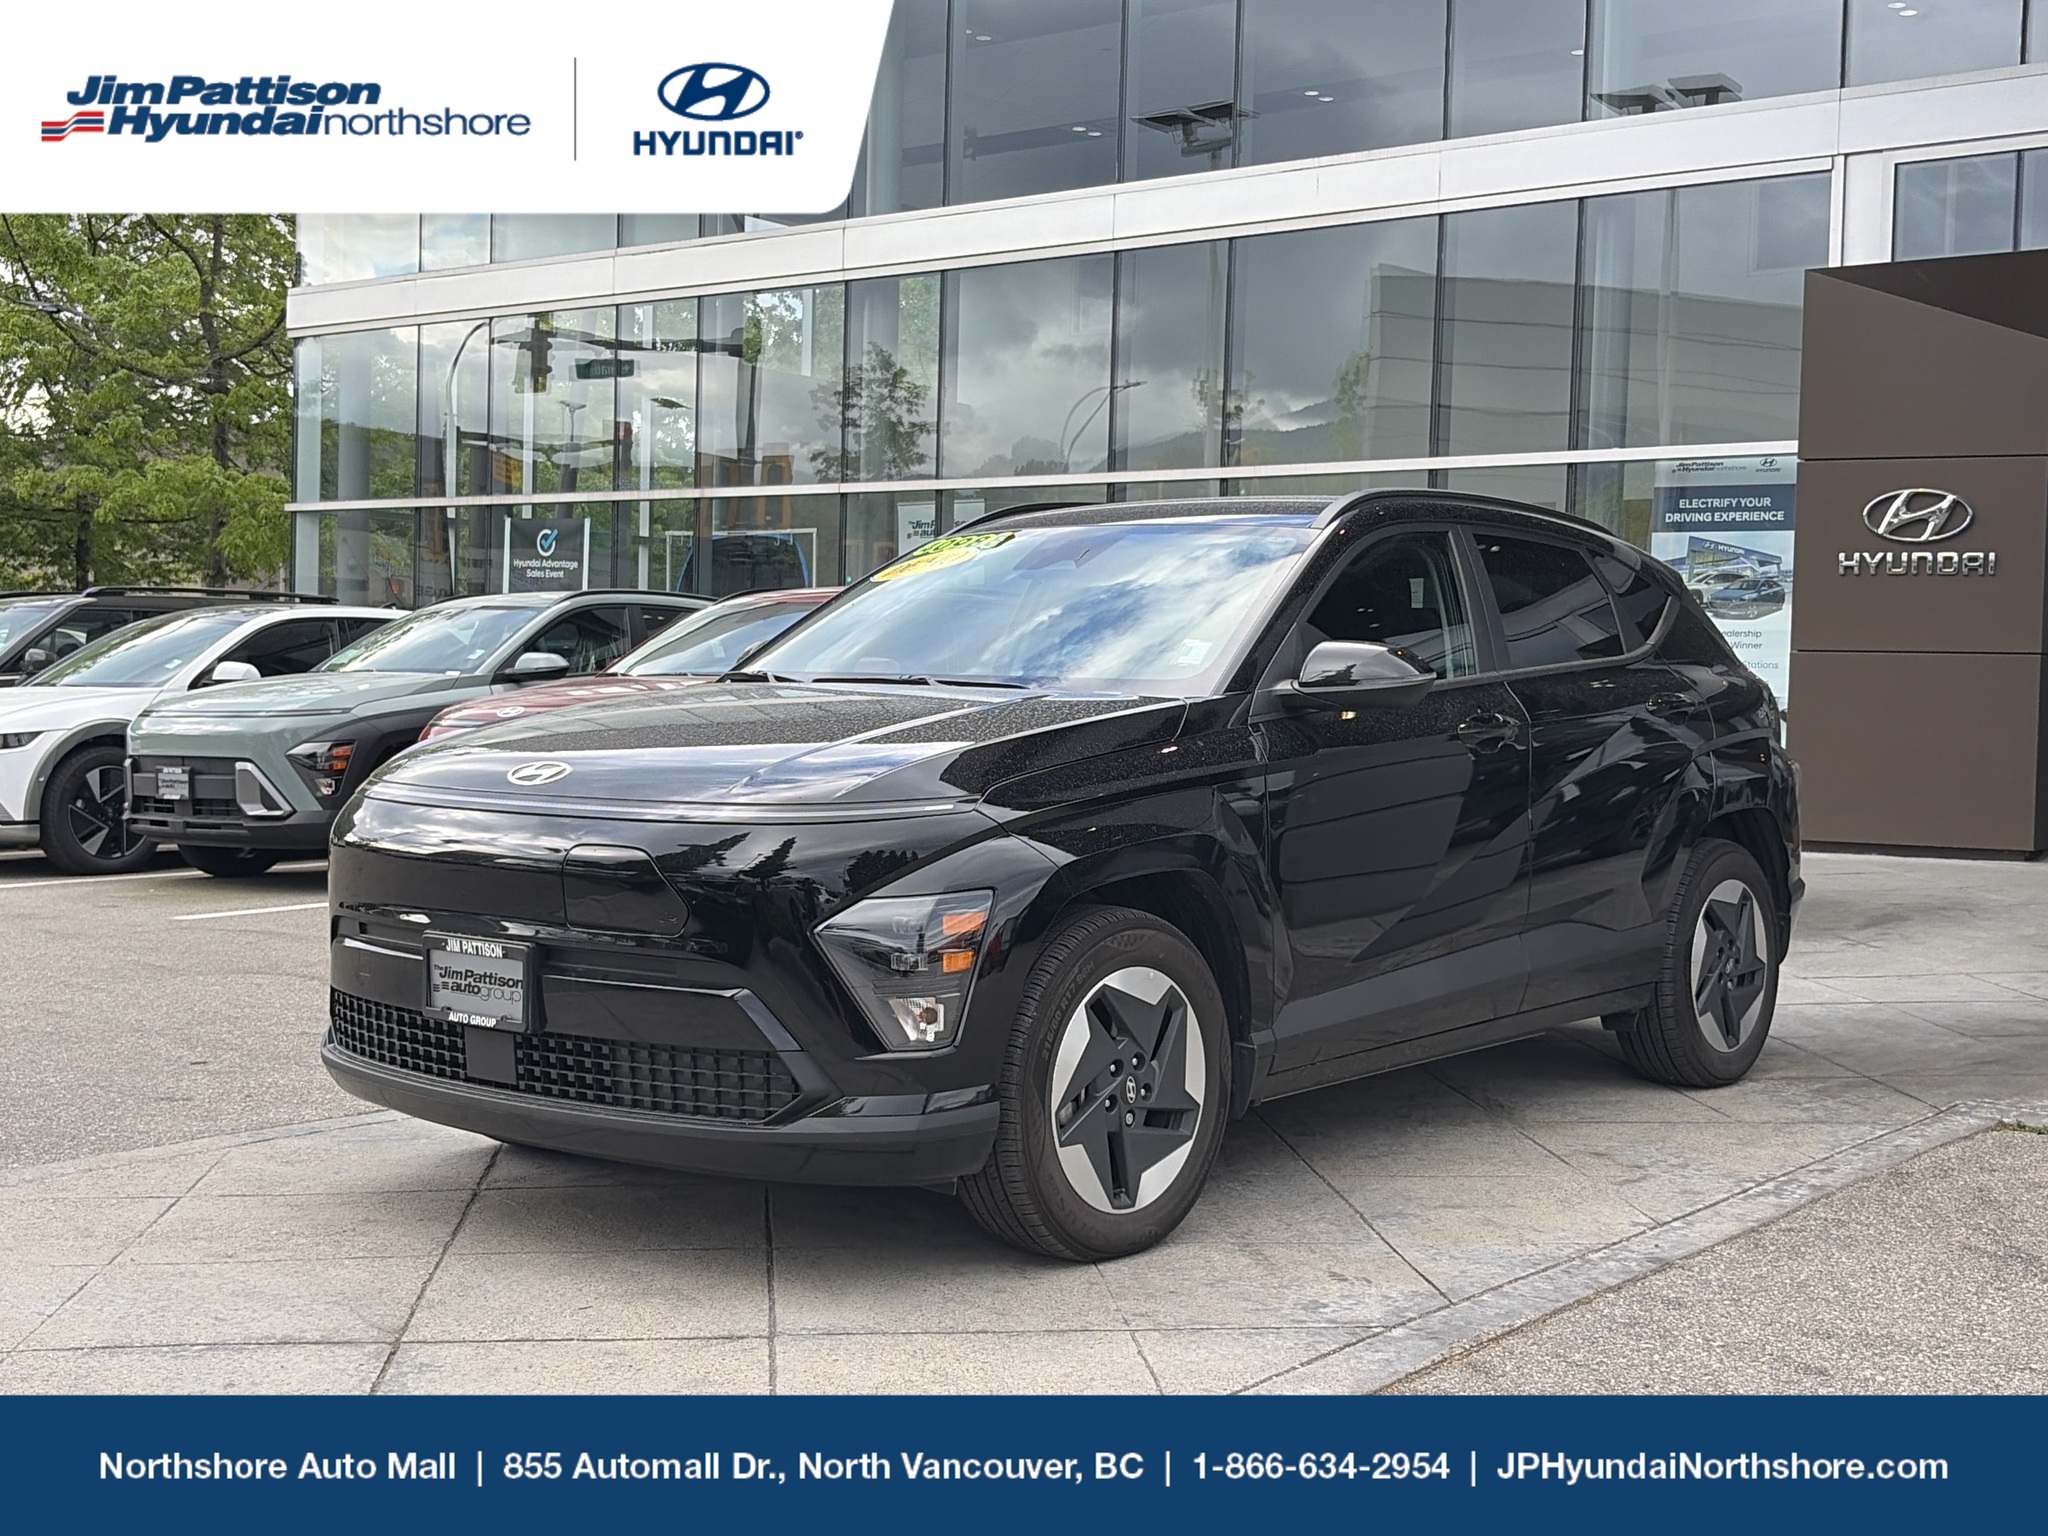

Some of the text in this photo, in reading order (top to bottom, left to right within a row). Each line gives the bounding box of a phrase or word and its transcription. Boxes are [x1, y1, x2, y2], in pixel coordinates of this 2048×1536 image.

[1679, 497, 1772, 509] ELECTRIFY YOUR
[1665, 511, 1785, 523] DRIVING EXPERIENCE
[513, 559, 578, 570] Hyundai Advantage
[1838, 551, 1996, 576] HYUNDAI
[526, 569, 564, 578] Sales Event
[1721, 630, 1762, 639] ealership
[1730, 641, 1762, 649] Winner
[446, 938, 503, 958] JIM PATTISON
[449, 1012, 497, 1027] AUTO GROUP
